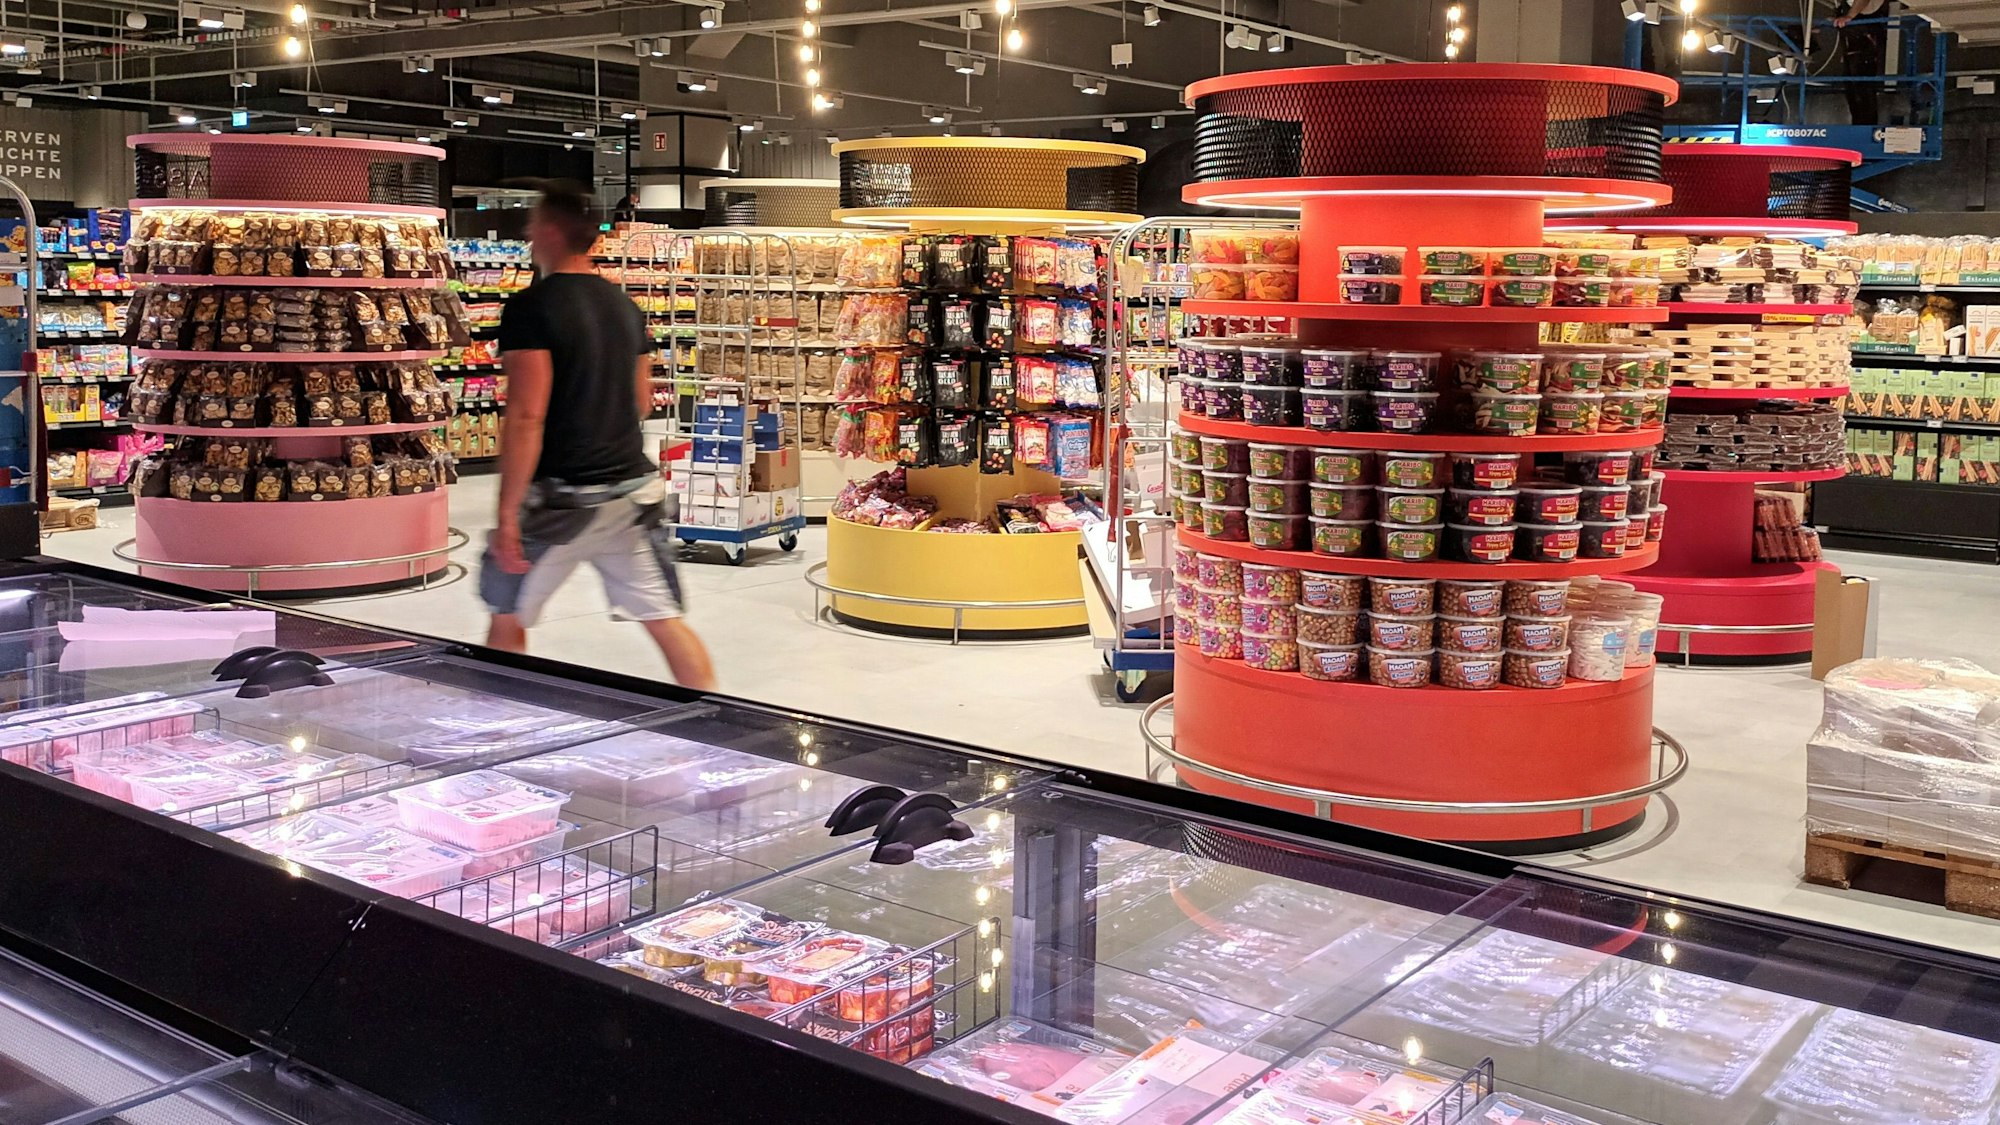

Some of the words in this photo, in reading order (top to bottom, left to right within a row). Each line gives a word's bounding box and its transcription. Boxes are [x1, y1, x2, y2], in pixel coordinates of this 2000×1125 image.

[0, 130, 60, 146] RVEN
[1520, 282, 1543, 290] HARIBO
[1505, 404, 1530, 412] HARIBO
[1552, 403, 1577, 411] HARIBO
[1390, 590, 1416, 600] MAOAM
[1468, 593, 1492, 603] MAOAM
[1538, 592, 1562, 602] MAOAM
[1379, 626, 1404, 635] MAOAM
[1461, 629, 1487, 638] MAOAM
[1524, 628, 1550, 637] MAOAM
[1321, 655, 1347, 664] MAOAM
[1388, 662, 1414, 671] MAOAM
[1464, 664, 1489, 673] MAOAM
[1537, 664, 1561, 673] MAOAM
